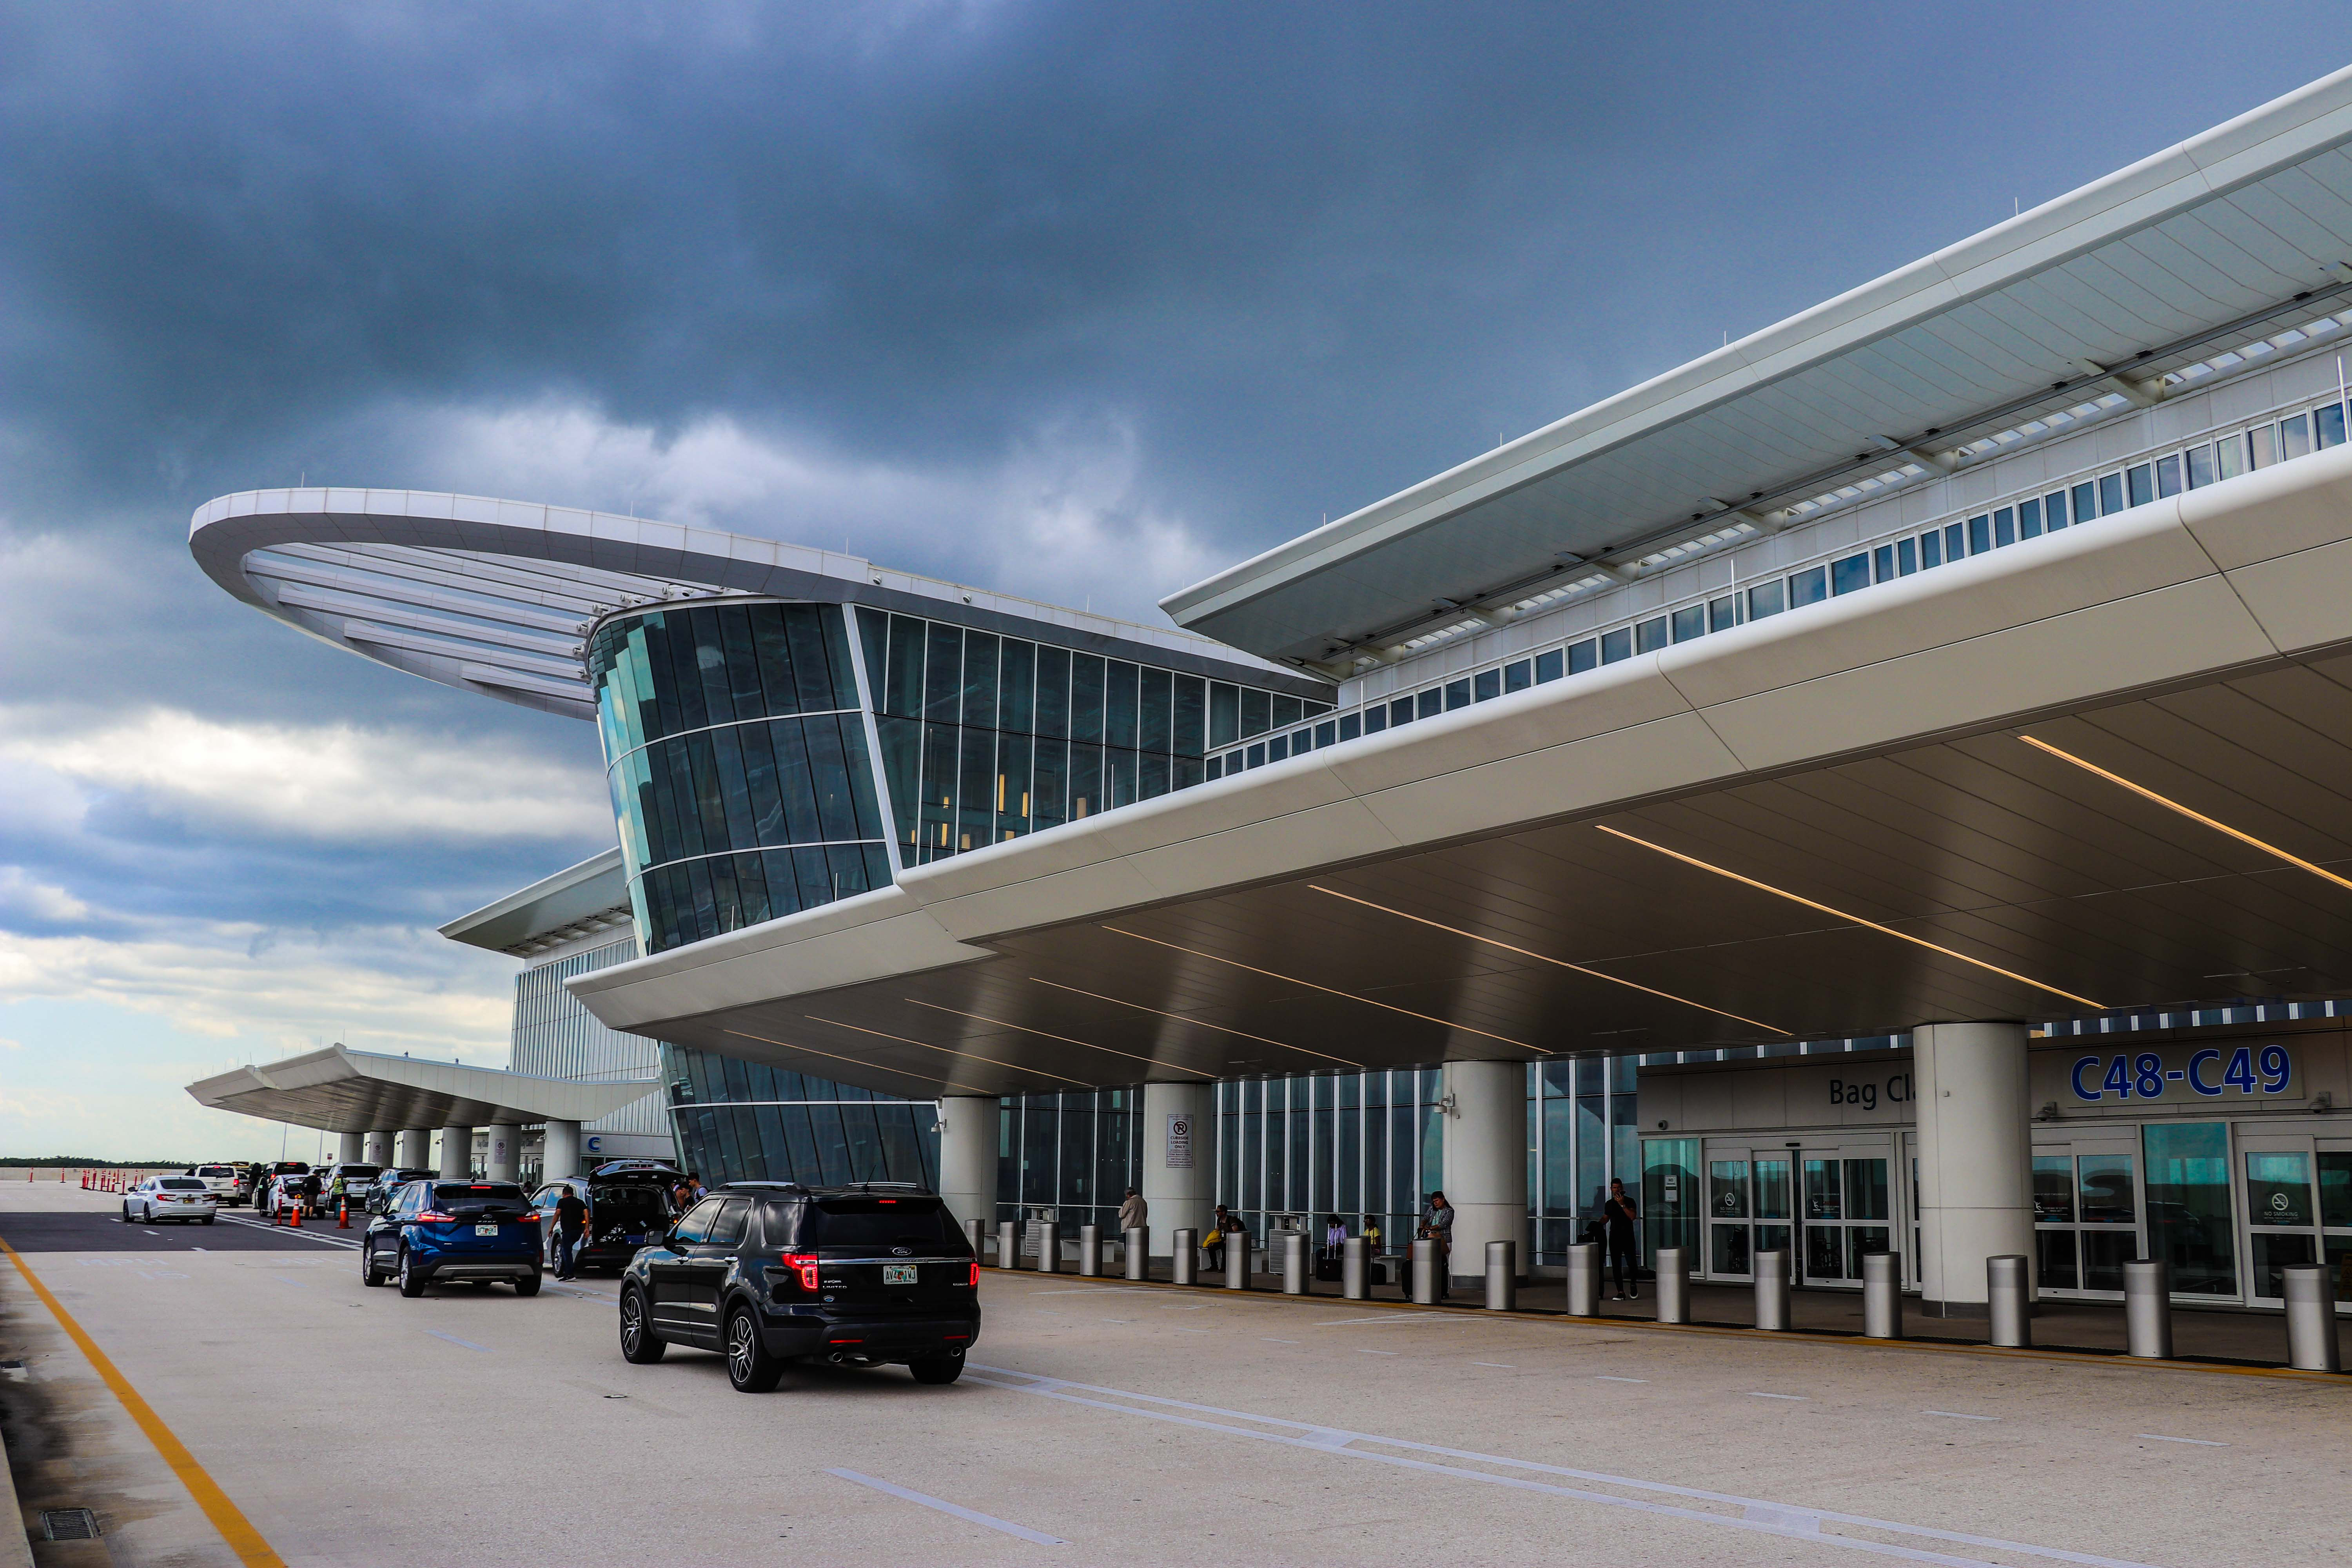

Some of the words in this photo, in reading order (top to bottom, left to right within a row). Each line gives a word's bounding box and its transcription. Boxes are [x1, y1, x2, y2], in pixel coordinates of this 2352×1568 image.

[1830, 1079, 1877, 1111] Bag
[1887, 1073, 1916, 1102] Cl
[2071, 1045, 2290, 1101] C48-C49
[588, 1137, 601, 1152] C
